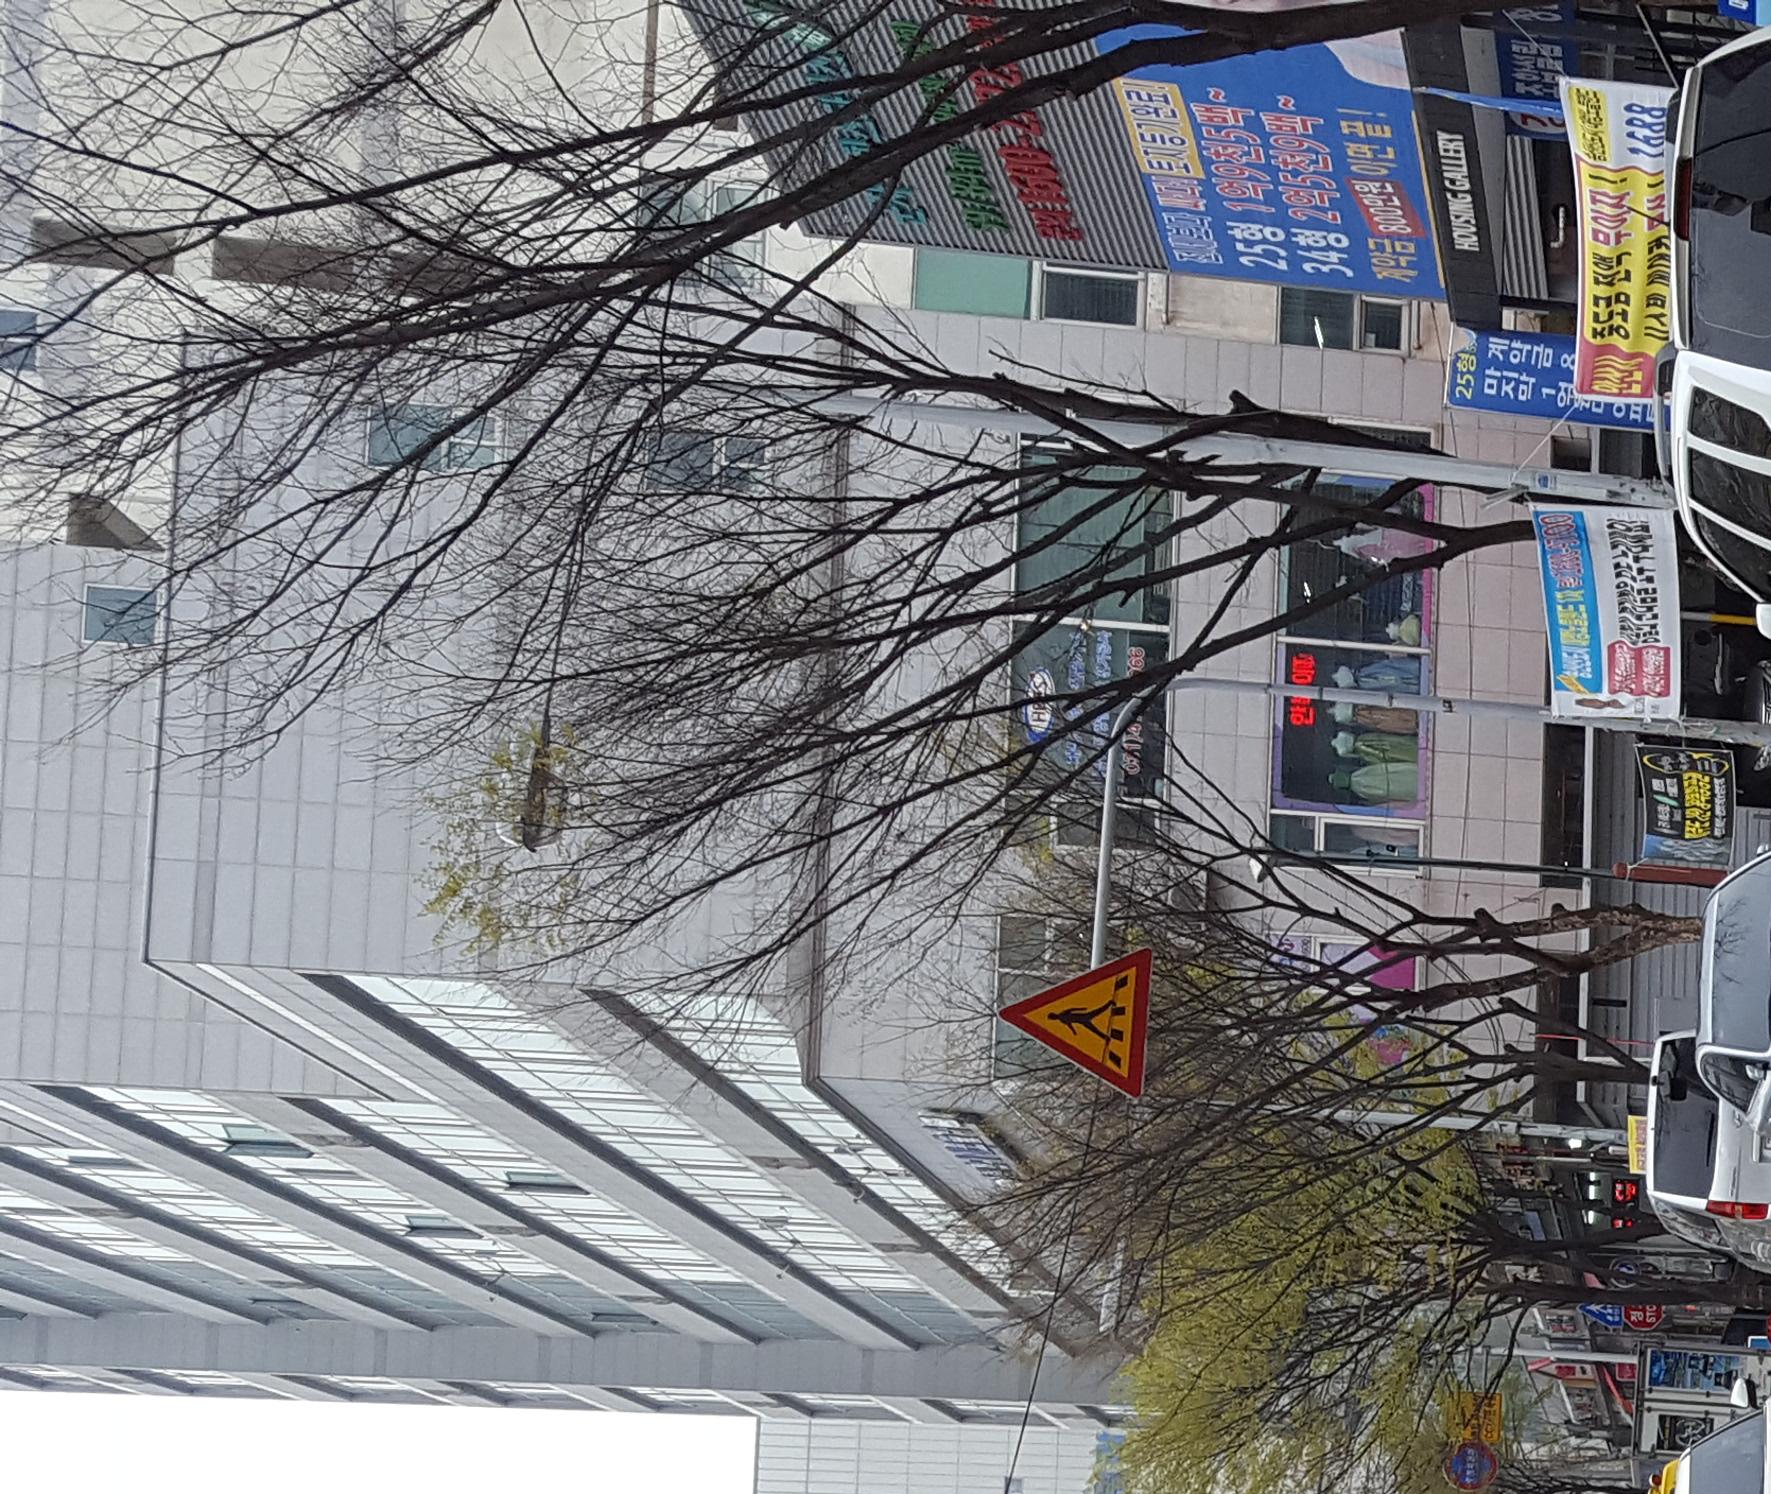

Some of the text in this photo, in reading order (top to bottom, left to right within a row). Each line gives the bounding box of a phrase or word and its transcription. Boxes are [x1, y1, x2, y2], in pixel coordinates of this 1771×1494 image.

[1119, 78, 1192, 175] 토지등기완료!
[1623, 102, 1667, 158] 1688
[1343, 143, 1399, 174] 이면
[1353, 179, 1413, 234] 800만원
[1436, 129, 1480, 251] HOUSING GALLERY
[1225, 220, 1289, 271] 25형
[1290, 227, 1355, 277] 34형
[1365, 236, 1419, 283] 계약금
[1591, 251, 1633, 287] 전액
[1591, 291, 1630, 340] 중도금
[1455, 353, 1476, 400] 25형
[1487, 336, 1556, 370] 계약금
[1484, 366, 1538, 402] 마지막
[1646, 1305, 1657, 1323] STO
